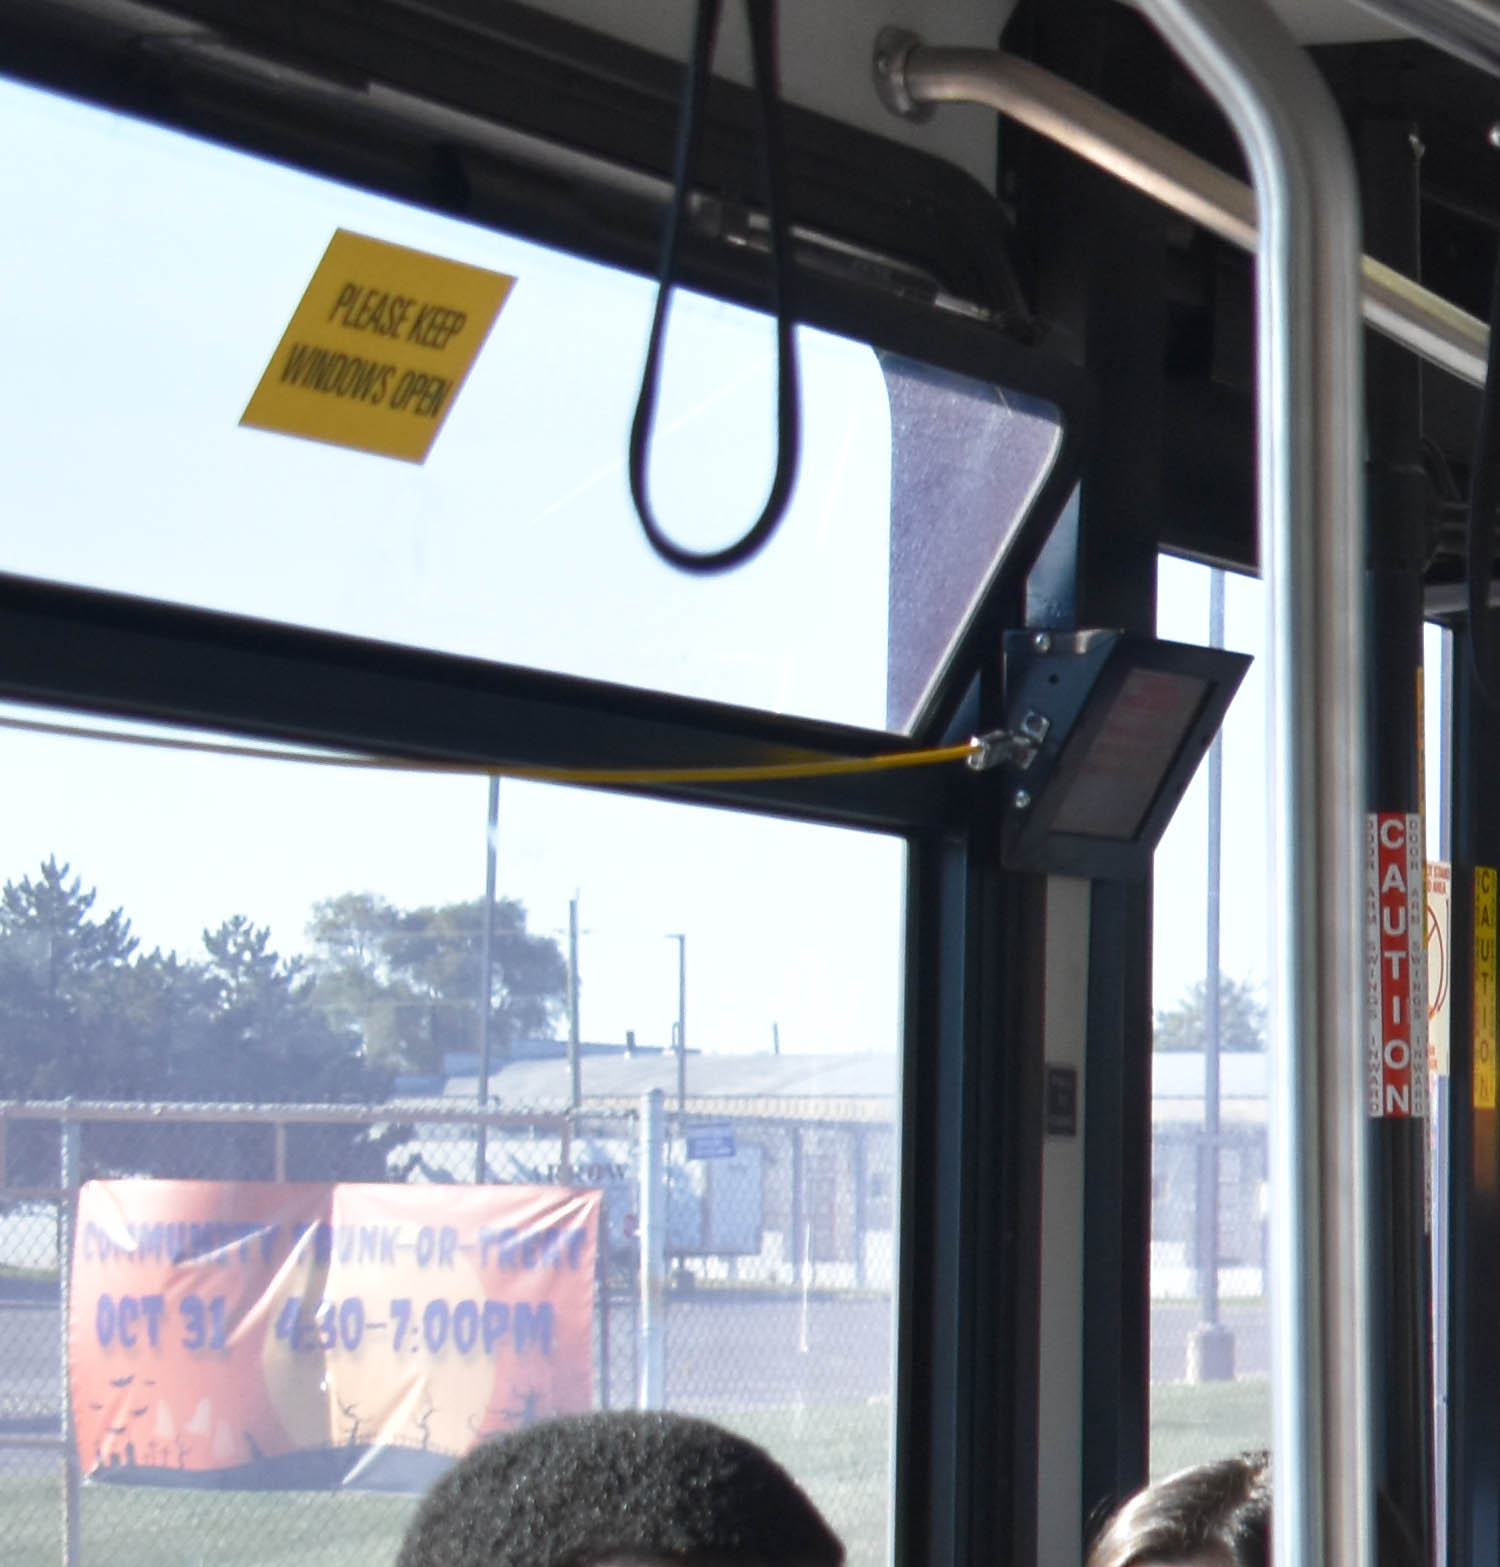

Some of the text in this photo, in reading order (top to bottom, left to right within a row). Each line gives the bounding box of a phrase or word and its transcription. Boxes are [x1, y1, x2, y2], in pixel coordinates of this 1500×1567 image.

[326, 282, 468, 351] PLEASE KEEP
[280, 343, 454, 419] WINDOWS OPEN
[1379, 818, 1410, 1115] CAUTION
[1480, 870, 1491, 1098] CAUTION
[95, 1294, 556, 1357] OCT 31 4:30-7:00PM
